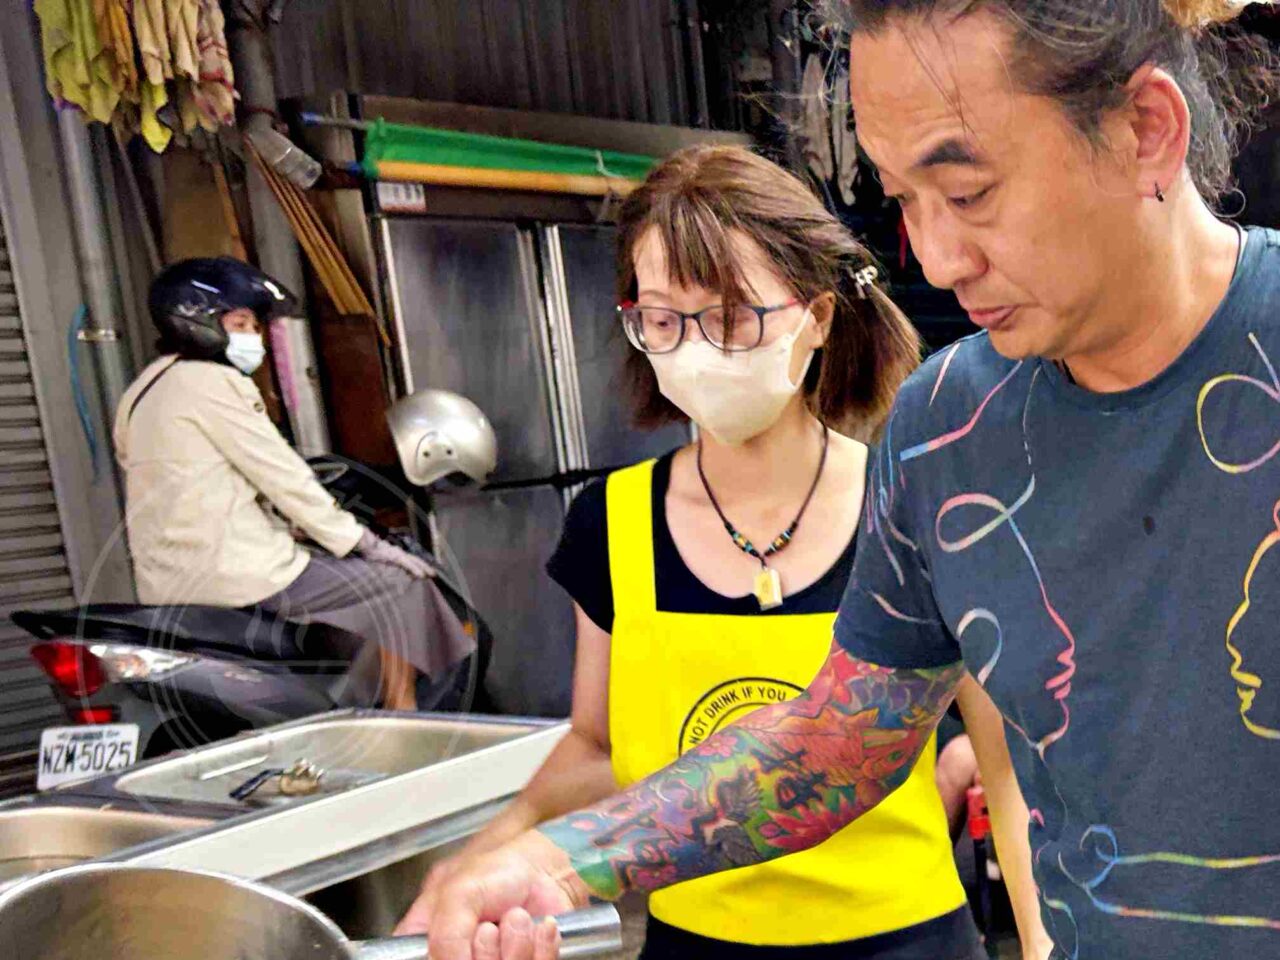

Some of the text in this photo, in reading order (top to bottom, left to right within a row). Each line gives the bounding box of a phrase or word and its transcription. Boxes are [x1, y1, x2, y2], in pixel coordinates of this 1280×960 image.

[704, 690, 739, 719] DRINK
[742, 686, 753, 698] IF
[758, 686, 787, 701] YOU
